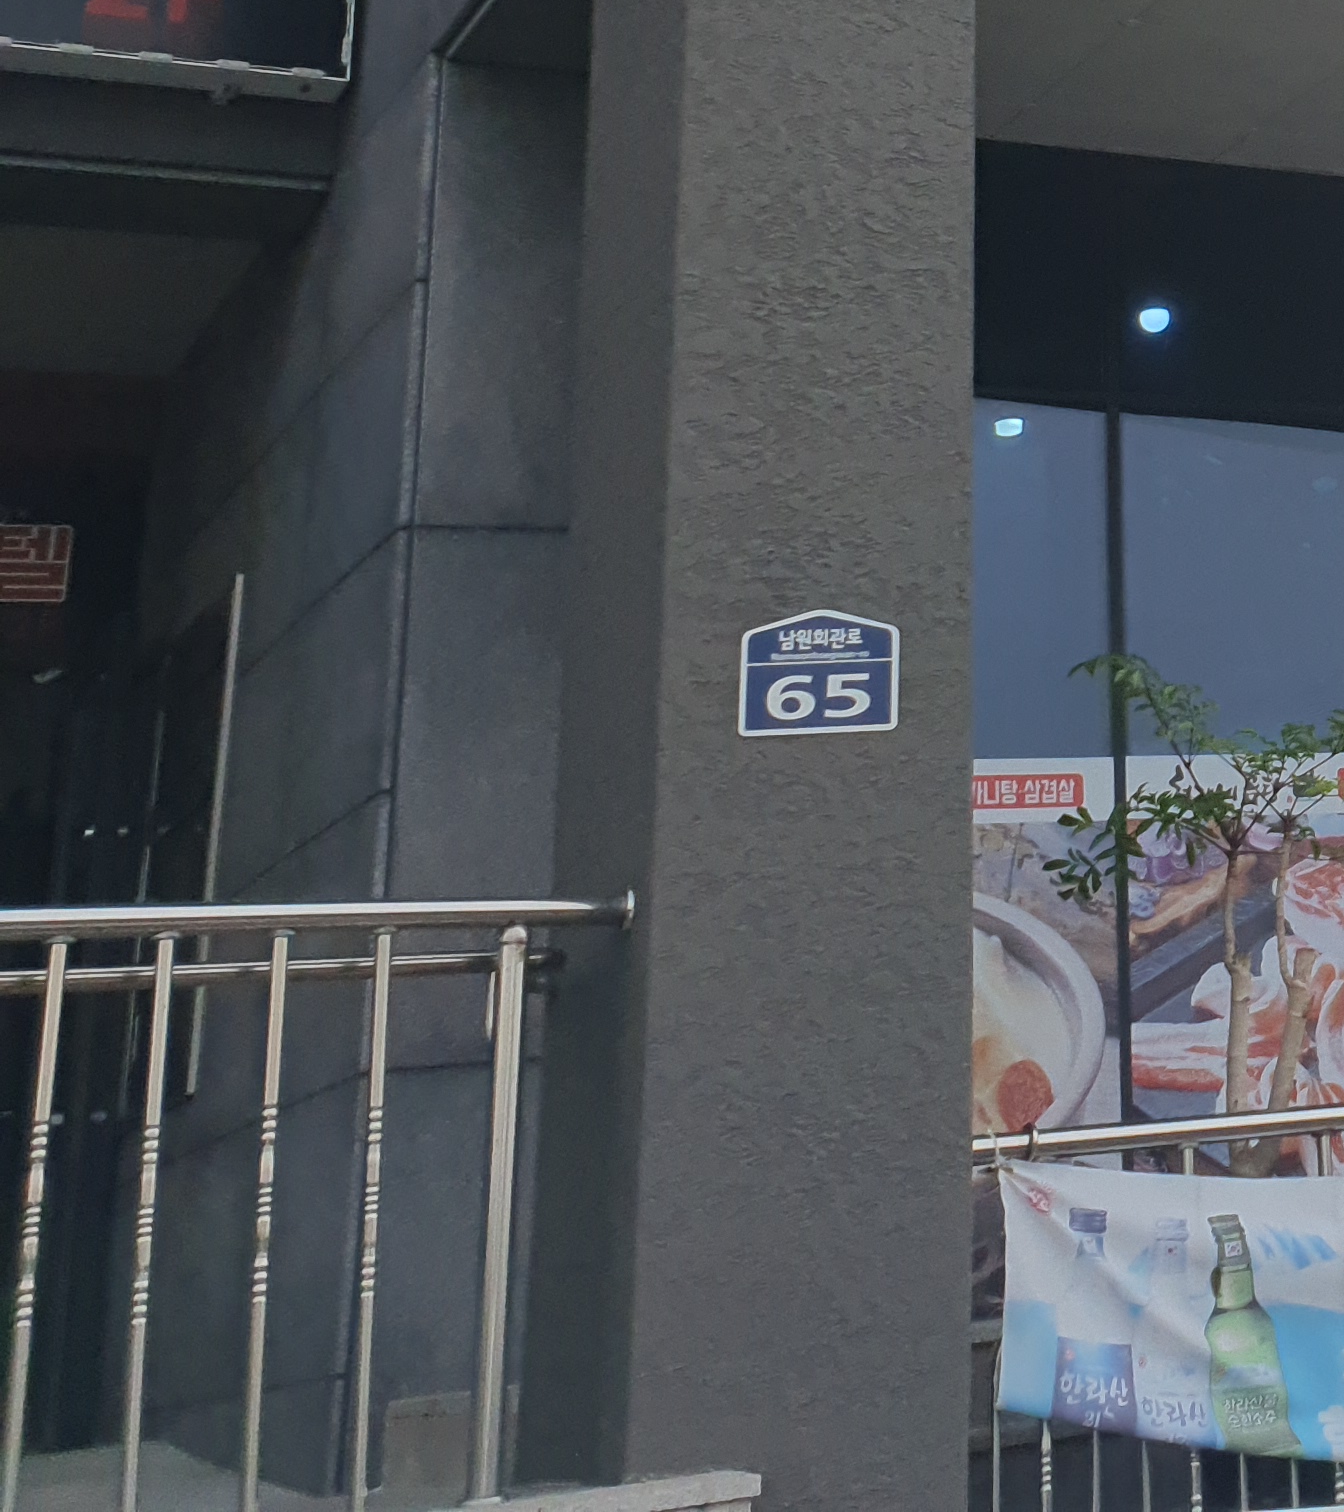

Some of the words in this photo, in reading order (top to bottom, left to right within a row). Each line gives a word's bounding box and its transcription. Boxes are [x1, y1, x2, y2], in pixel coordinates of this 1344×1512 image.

[778, 628, 863, 651] 남원회관로
[766, 673, 871, 720] 65
[1060, 1371, 1128, 1407] 한라산
[1141, 1396, 1207, 1428] 한라산
